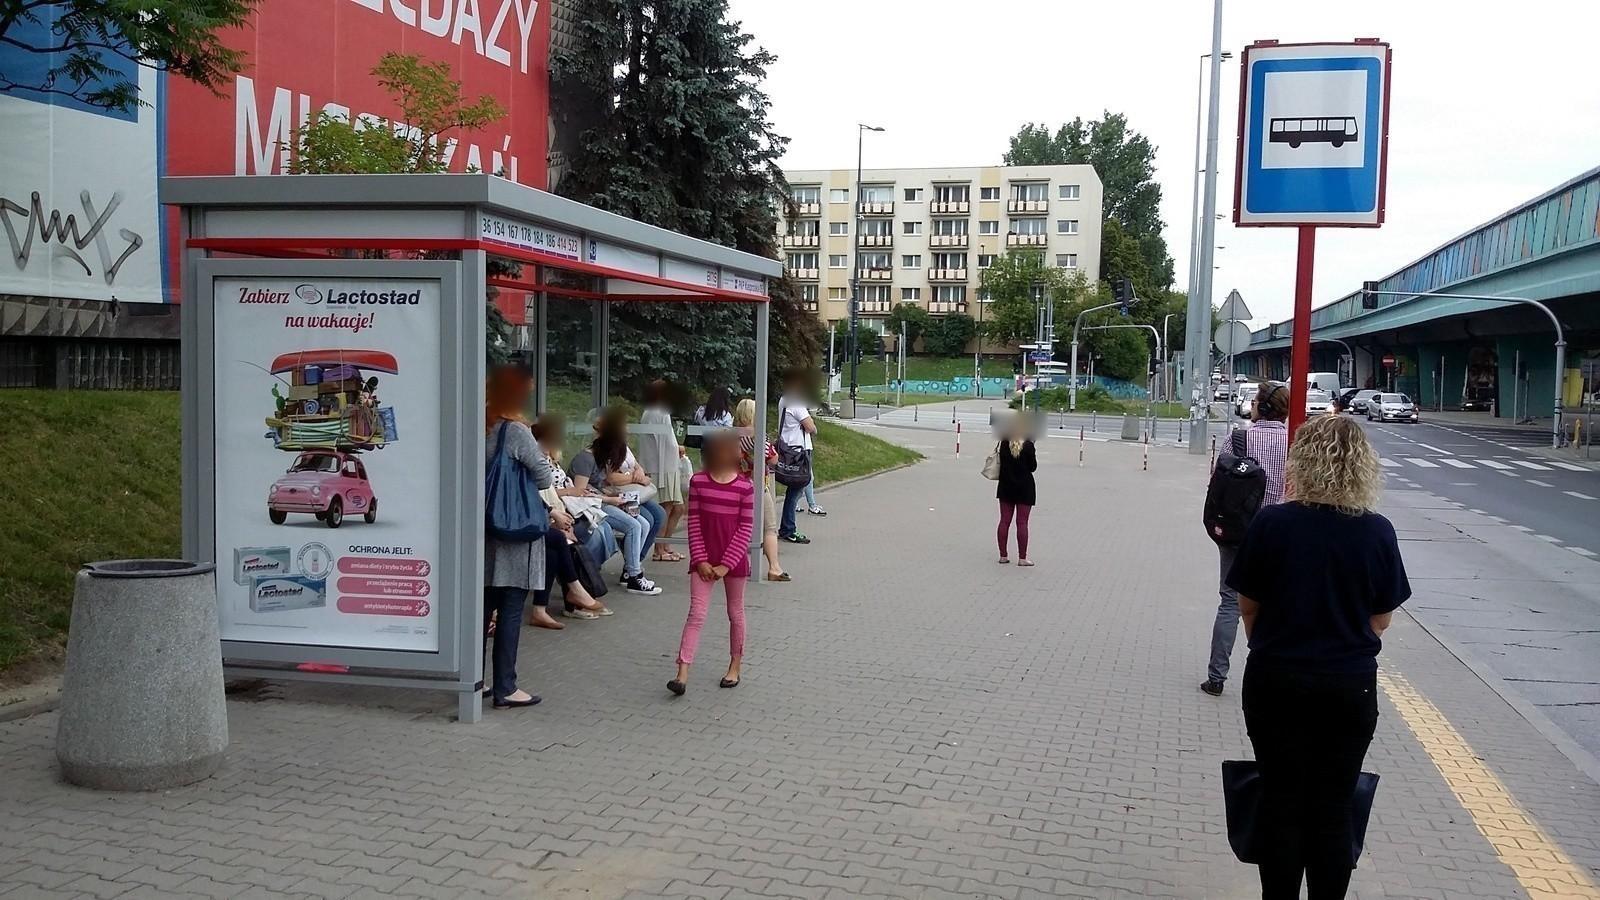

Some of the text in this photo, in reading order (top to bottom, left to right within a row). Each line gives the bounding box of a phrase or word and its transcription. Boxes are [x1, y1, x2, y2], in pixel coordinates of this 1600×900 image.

[482, 218, 578, 253] 36 154 167 178 184 186 414 523
[239, 287, 421, 305] Zabierz Lactostad
[285, 312, 375, 333] na wakacje!
[348, 545, 413, 555] OCHRONA JELIT:
[258, 587, 303, 599] Lactostad
